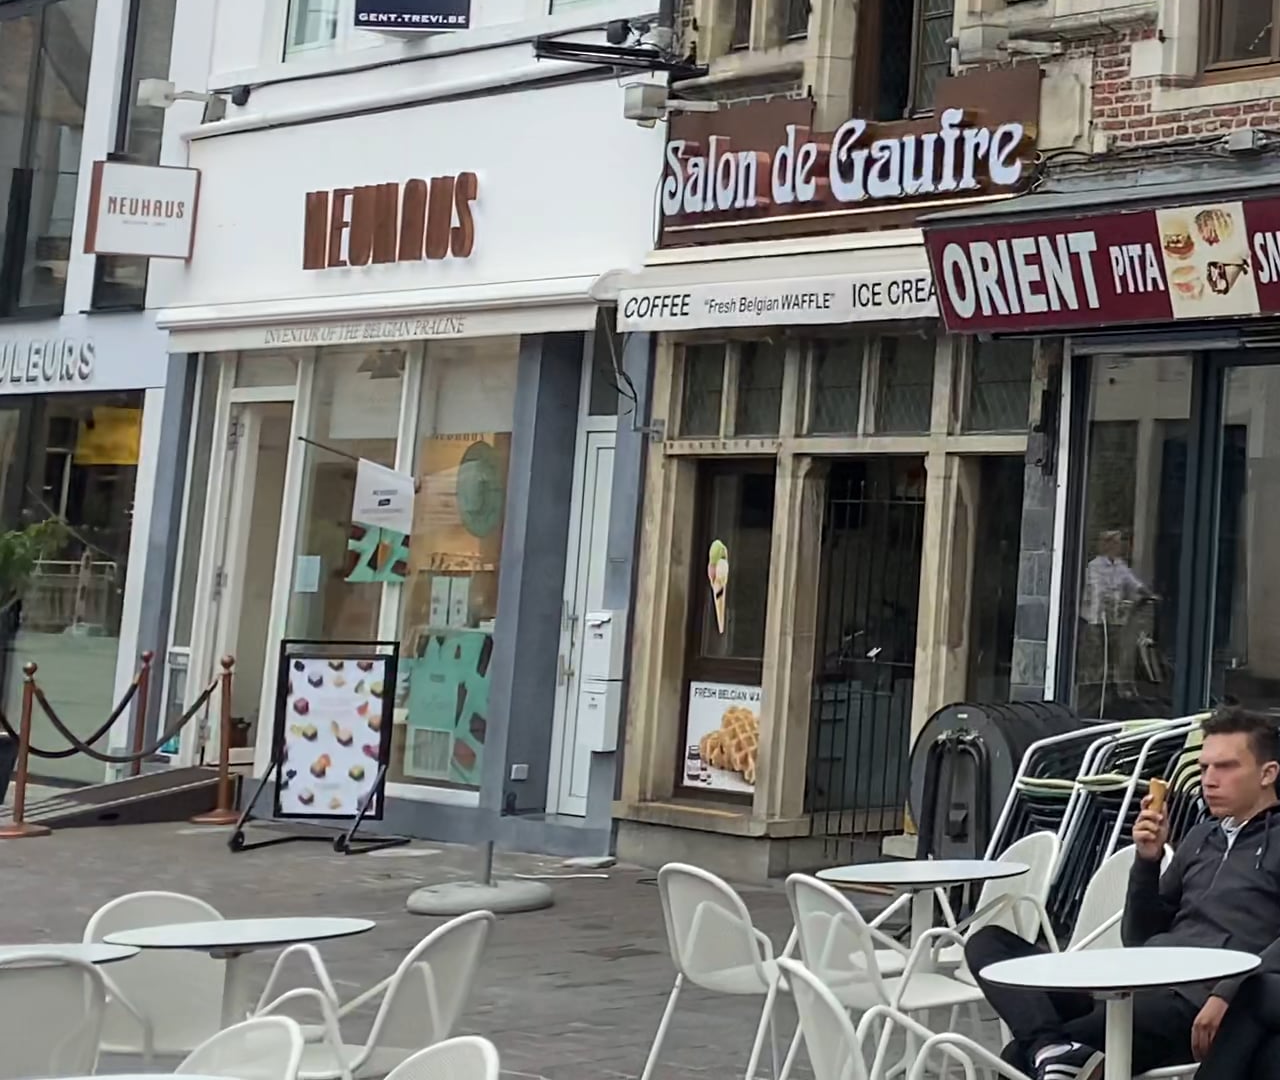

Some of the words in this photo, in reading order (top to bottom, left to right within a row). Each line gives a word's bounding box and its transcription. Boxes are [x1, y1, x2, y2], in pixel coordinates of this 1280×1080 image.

[358, 12, 467, 24] GENT.TREVI.BE
[663, 134, 758, 217] Salon
[771, 123, 821, 205] de
[829, 107, 1025, 203] Gaufre
[107, 195, 185, 219] NEUHAUS
[941, 230, 1100, 319] ORIENT
[1108, 241, 1166, 295] PITA
[623, 292, 692, 319] COFFEE
[738, 295, 780, 316] Belgian
[852, 282, 882, 308] ICE
